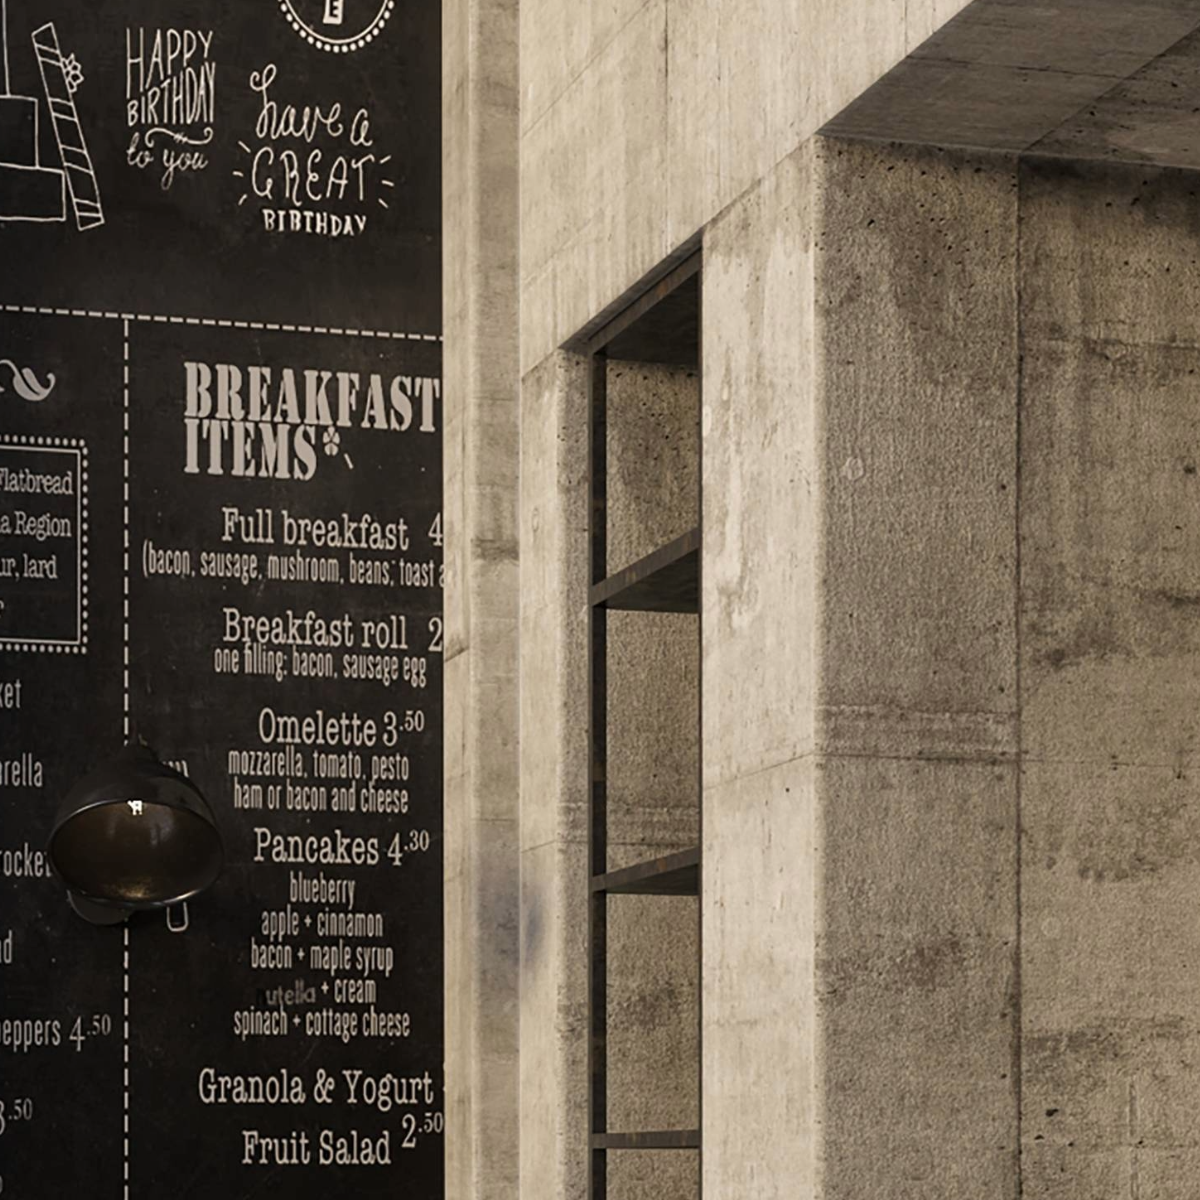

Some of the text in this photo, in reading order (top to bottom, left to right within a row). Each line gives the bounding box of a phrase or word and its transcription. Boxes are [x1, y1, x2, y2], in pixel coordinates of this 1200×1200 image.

[126, 28, 213, 98] HAPPY
[127, 62, 216, 127] BIRTHDAY
[250, 64, 373, 146] have a
[127, 132, 208, 190] to you
[251, 146, 375, 206] GREAT
[263, 209, 367, 237] BIRTHDAY
[184, 361, 440, 432] BREAKFAST
[15, 511, 72, 542] Region
[222, 507, 274, 545] Full
[281, 510, 409, 552] breakfast
[23, 554, 57, 580] lard
[142, 541, 196, 579] (bacon,
[200, 551, 262, 586] sausage,
[267, 550, 344, 584] mushroom,
[399, 557, 436, 588] toast
[223, 607, 354, 648] Breakfast
[361, 615, 407, 650] roll
[214, 641, 426, 688] one filling: bacon, sausage egg
[259, 707, 425, 748] Omelette 3.50
[229, 746, 409, 786] mozzarella, tomato, pesto
[234, 777, 408, 814] ham or bacon and cheese
[254, 827, 430, 866] Pancakes 4.30
[290, 871, 355, 910] blueberry
[262, 909, 299, 942] apple
[317, 910, 383, 937] cinnamon
[251, 938, 292, 969] bacon
[310, 943, 351, 977] maple
[356, 945, 393, 977] syrup
[262, 977, 316, 1007] utella
[335, 978, 376, 1004] cream
[234, 1005, 288, 1039] spinach
[306, 1008, 359, 1042] cottage
[362, 1006, 410, 1037] cheese
[199, 1068, 433, 1112] Granola & Yogurt
[242, 1130, 310, 1165] Fruit
[319, 1130, 391, 1165] Salad
